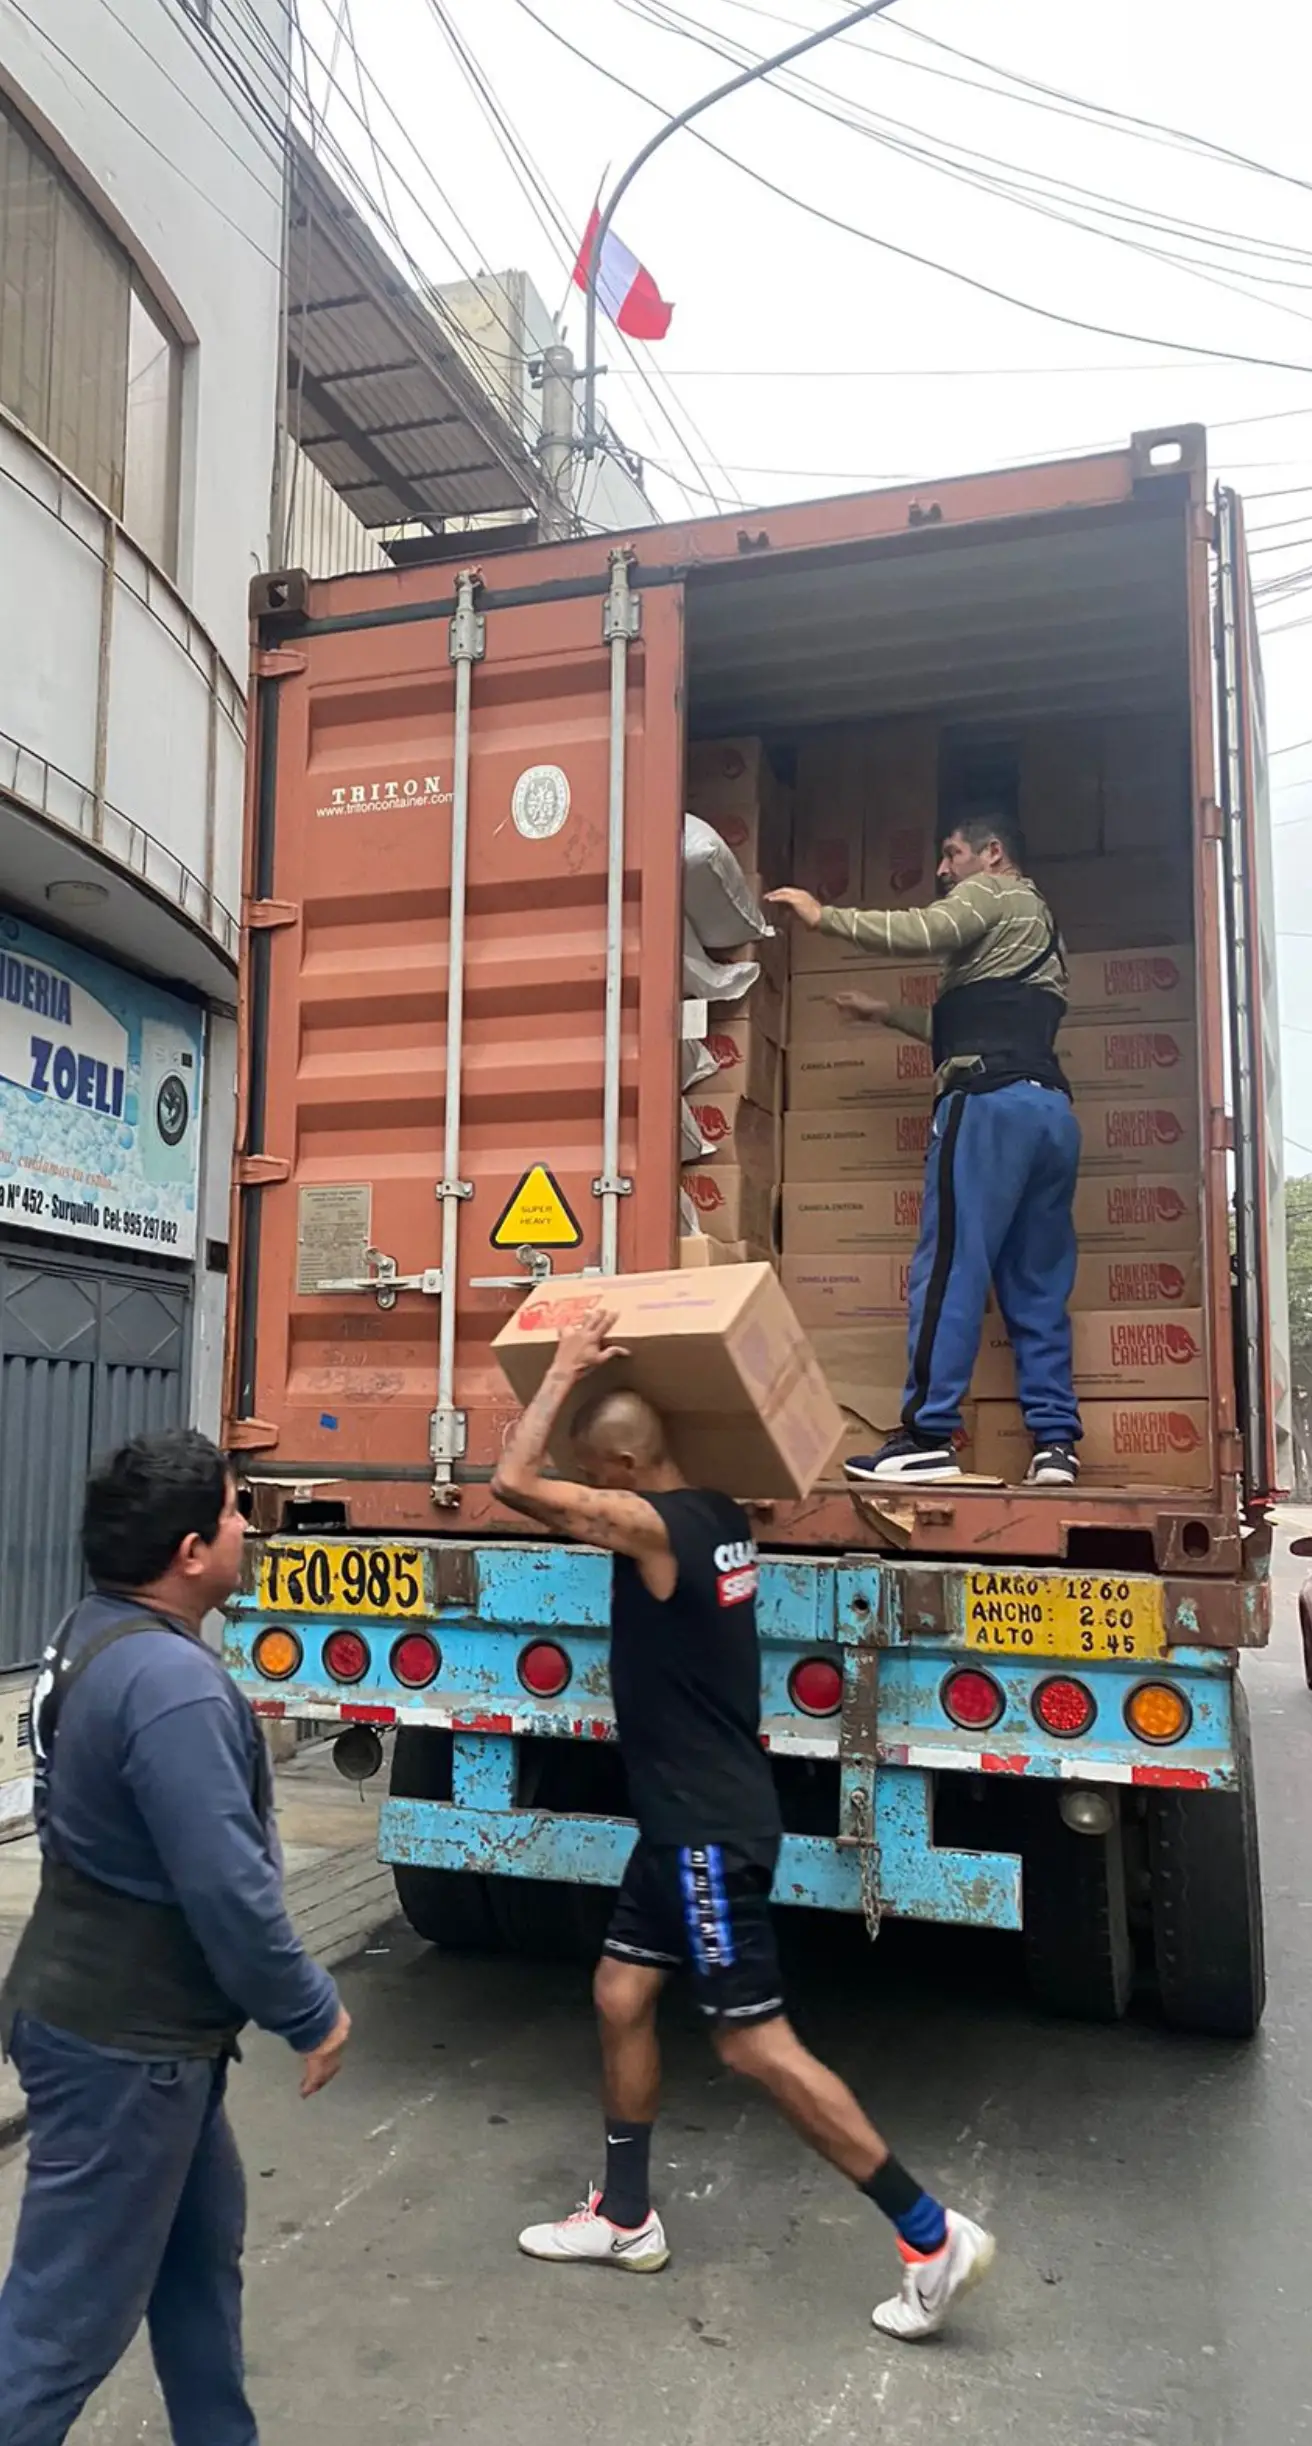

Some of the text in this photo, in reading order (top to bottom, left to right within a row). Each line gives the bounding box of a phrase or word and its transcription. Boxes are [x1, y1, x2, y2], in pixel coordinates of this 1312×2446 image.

[332, 776, 440, 805] TRITON
[30, 1035, 124, 1117] ZOELI
[1107, 1186, 1158, 1207] LANKAN
[22, 1186, 44, 1215] 452
[51, 1194, 99, 1227] Surquillo
[124, 1211, 142, 1236] 995
[143, 1216, 160, 1240] 297
[520, 1217, 553, 1225] HEAVY
[521, 1205, 553, 1214] SUPER
[1108, 1204, 1156, 1224] CANELA
[1108, 1264, 1159, 1285] LANKAN
[1109, 1282, 1158, 1302] CANELA
[1110, 1323, 1165, 1346] LANKAN
[1111, 1344, 1164, 1367] CANELA
[1112, 1411, 1168, 1434] LANKAN
[1114, 1431, 1167, 1454] CANELA
[1066, 1580, 1130, 1601] 12.60
[1080, 1630, 1136, 1654] 3.45
